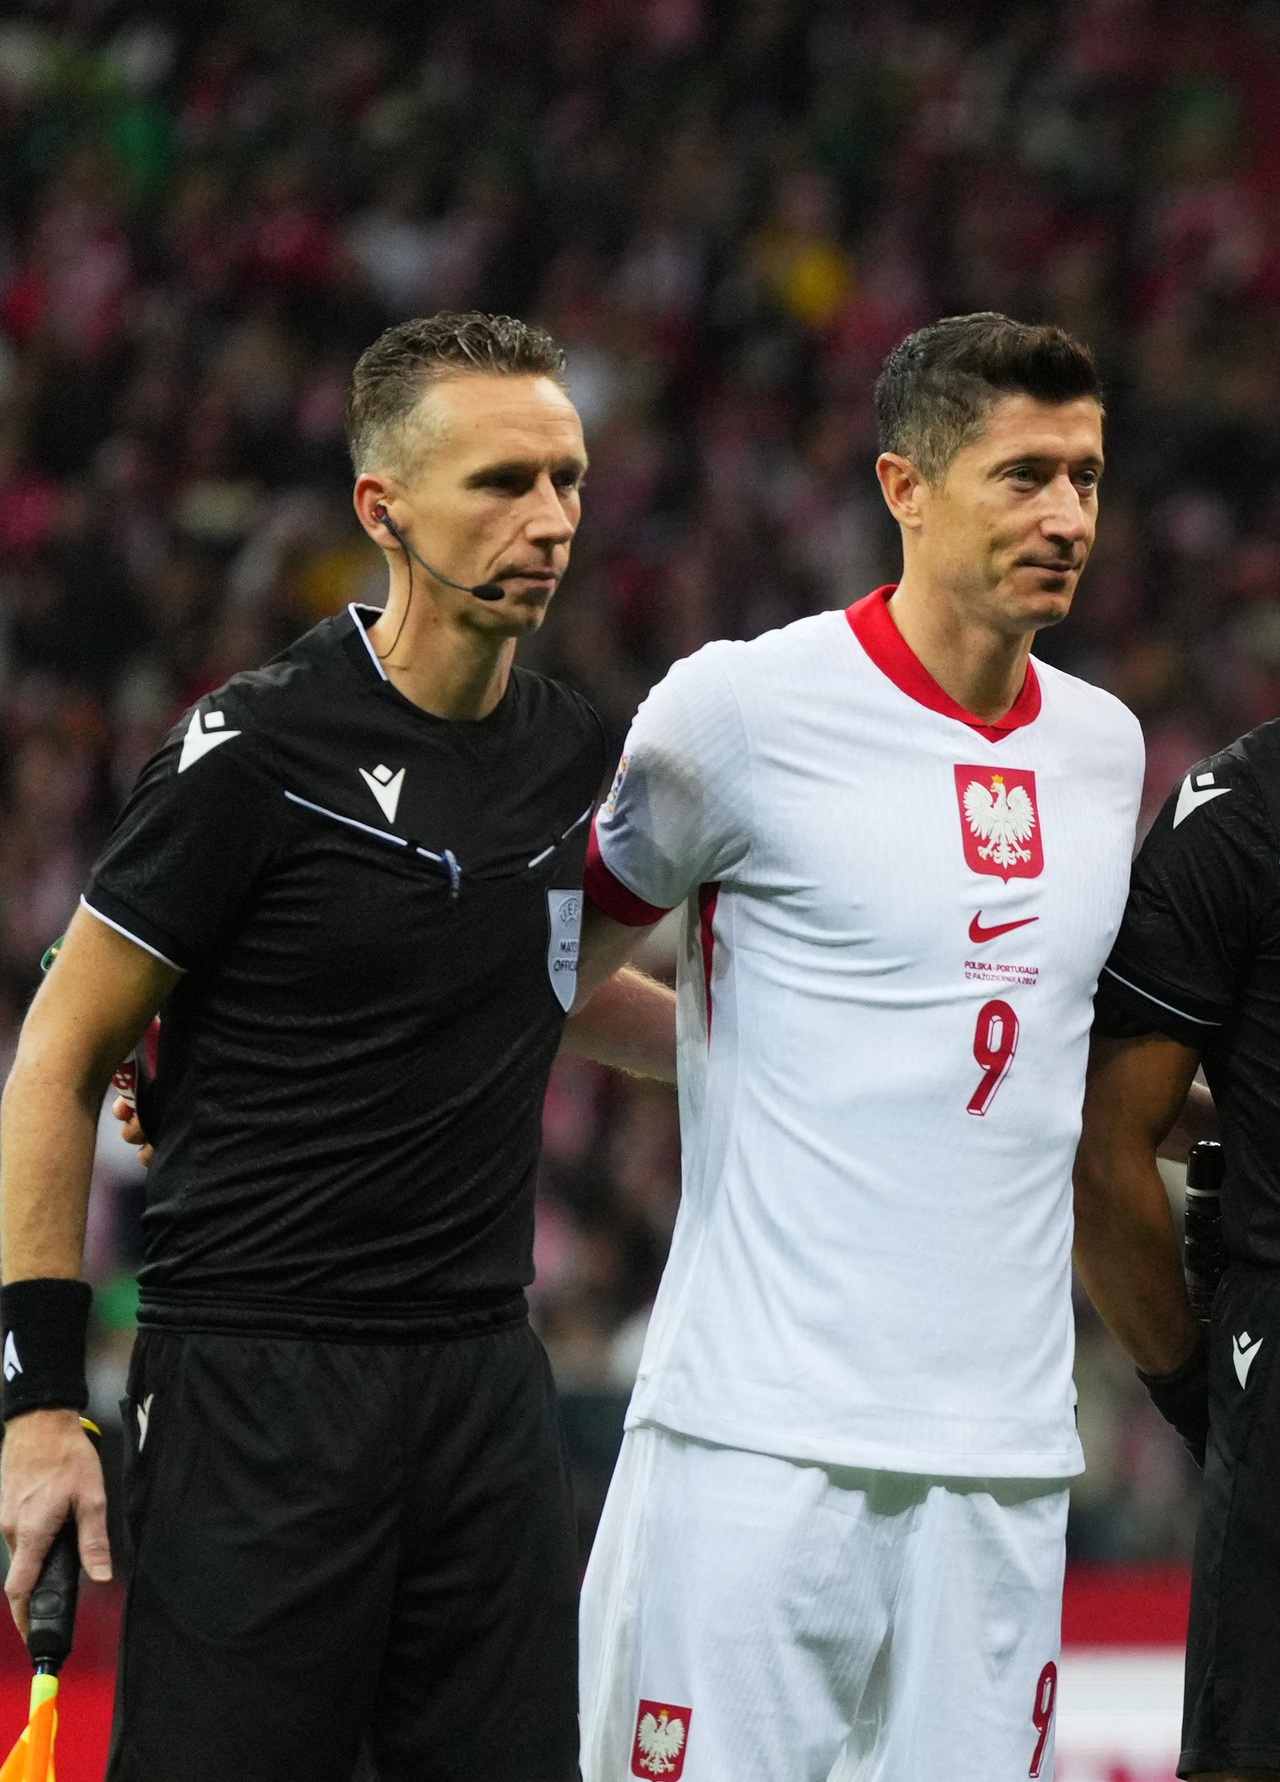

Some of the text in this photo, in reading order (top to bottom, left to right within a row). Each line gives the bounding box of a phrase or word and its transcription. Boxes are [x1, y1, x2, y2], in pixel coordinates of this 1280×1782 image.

[560, 941, 577, 952] MATC
[965, 961, 992, 971] POLSKA
[996, 965, 1039, 975] PORTUGALIA
[966, 999, 1020, 1116] 9
[1028, 1661, 1058, 1778] 9
